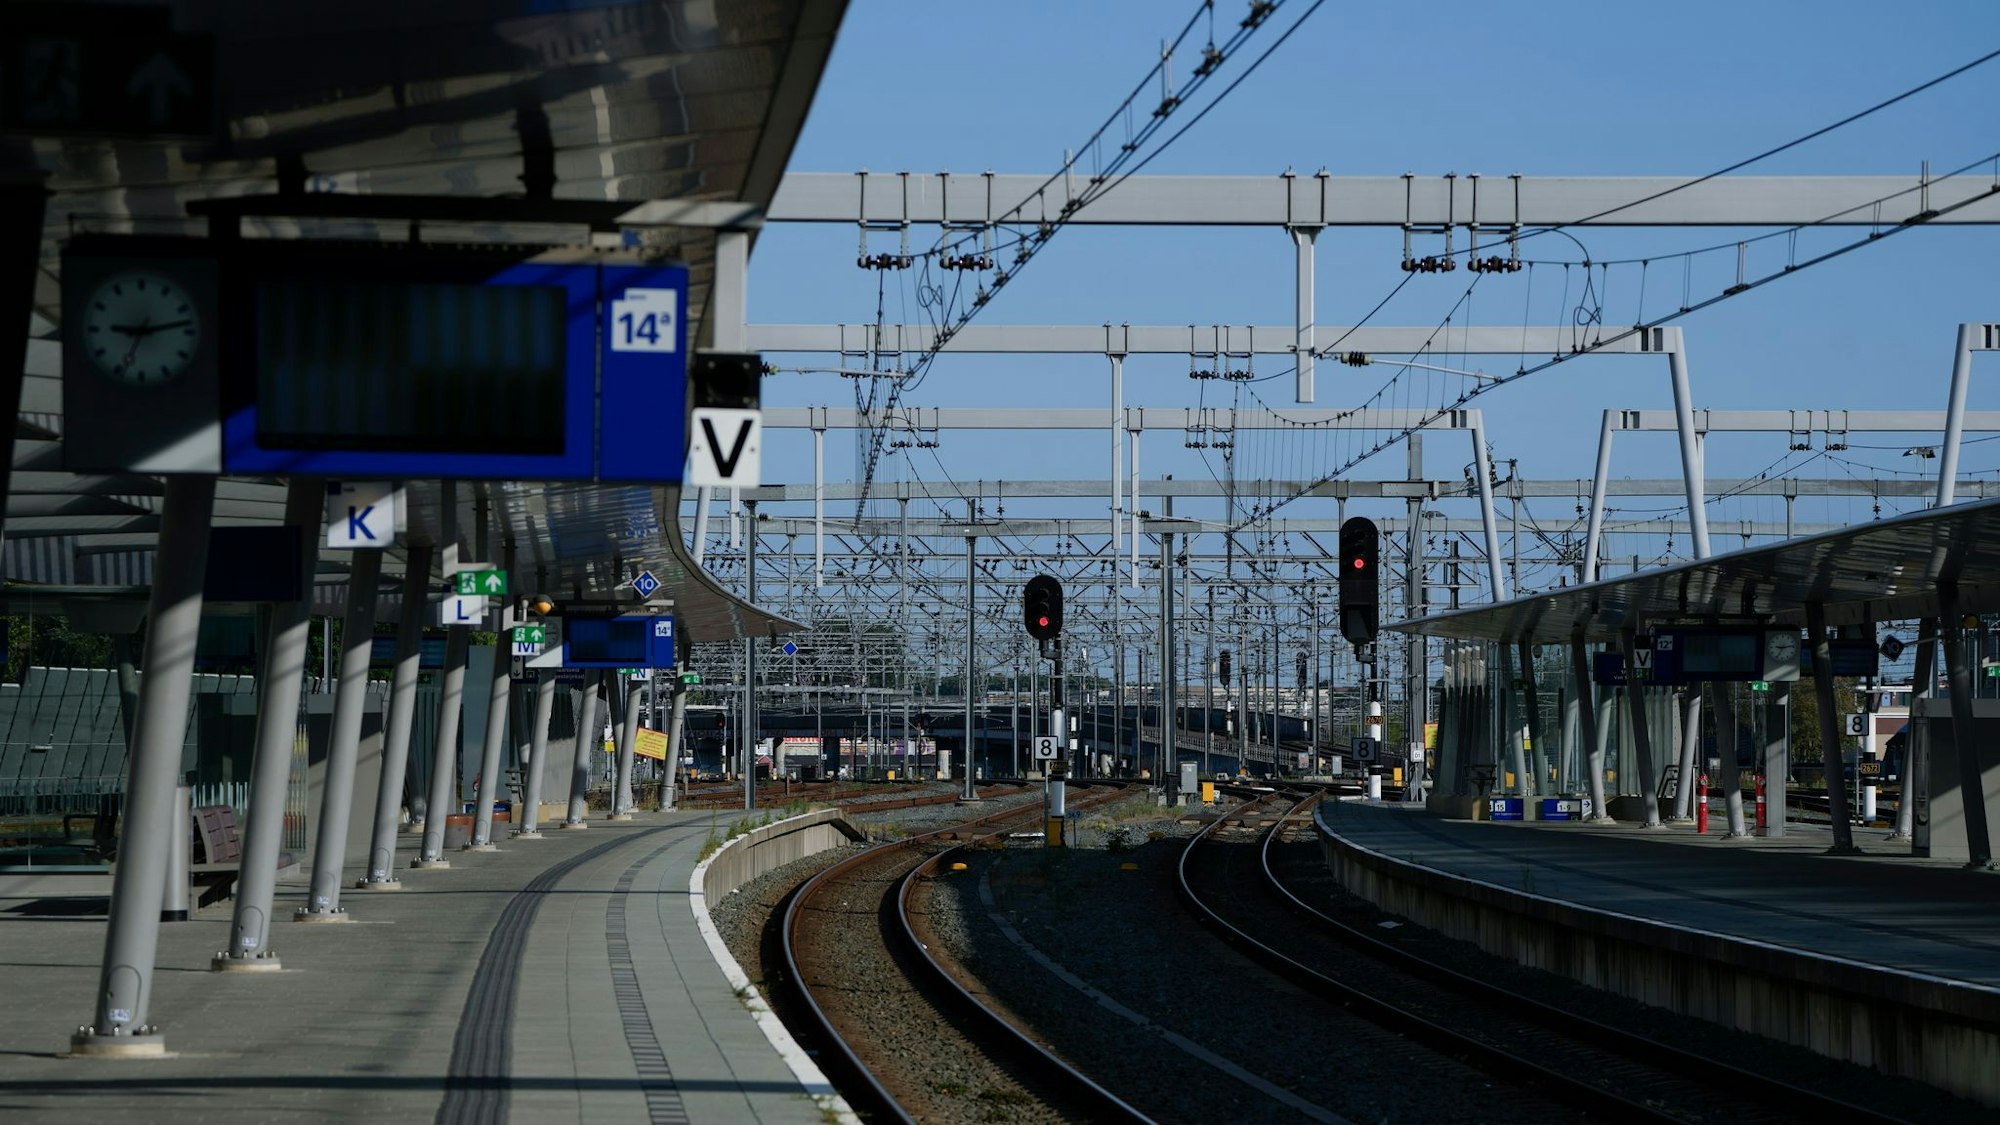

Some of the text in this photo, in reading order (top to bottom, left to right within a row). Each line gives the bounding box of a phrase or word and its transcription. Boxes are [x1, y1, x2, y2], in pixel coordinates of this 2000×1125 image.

[701, 418, 753, 478] V
[348, 506, 376, 540] K
[639, 578, 655, 590] 10
[457, 600, 470, 620] L
[518, 642, 535, 652] M
[1636, 651, 1649, 666] V
[637, 668, 646, 678] N
[1366, 716, 1383, 724] 2670
[1852, 716, 1862, 732] 8
[1041, 739, 1051, 756] 8
[1359, 741, 1369, 757] 8
[1862, 764, 1879, 772] 2672
